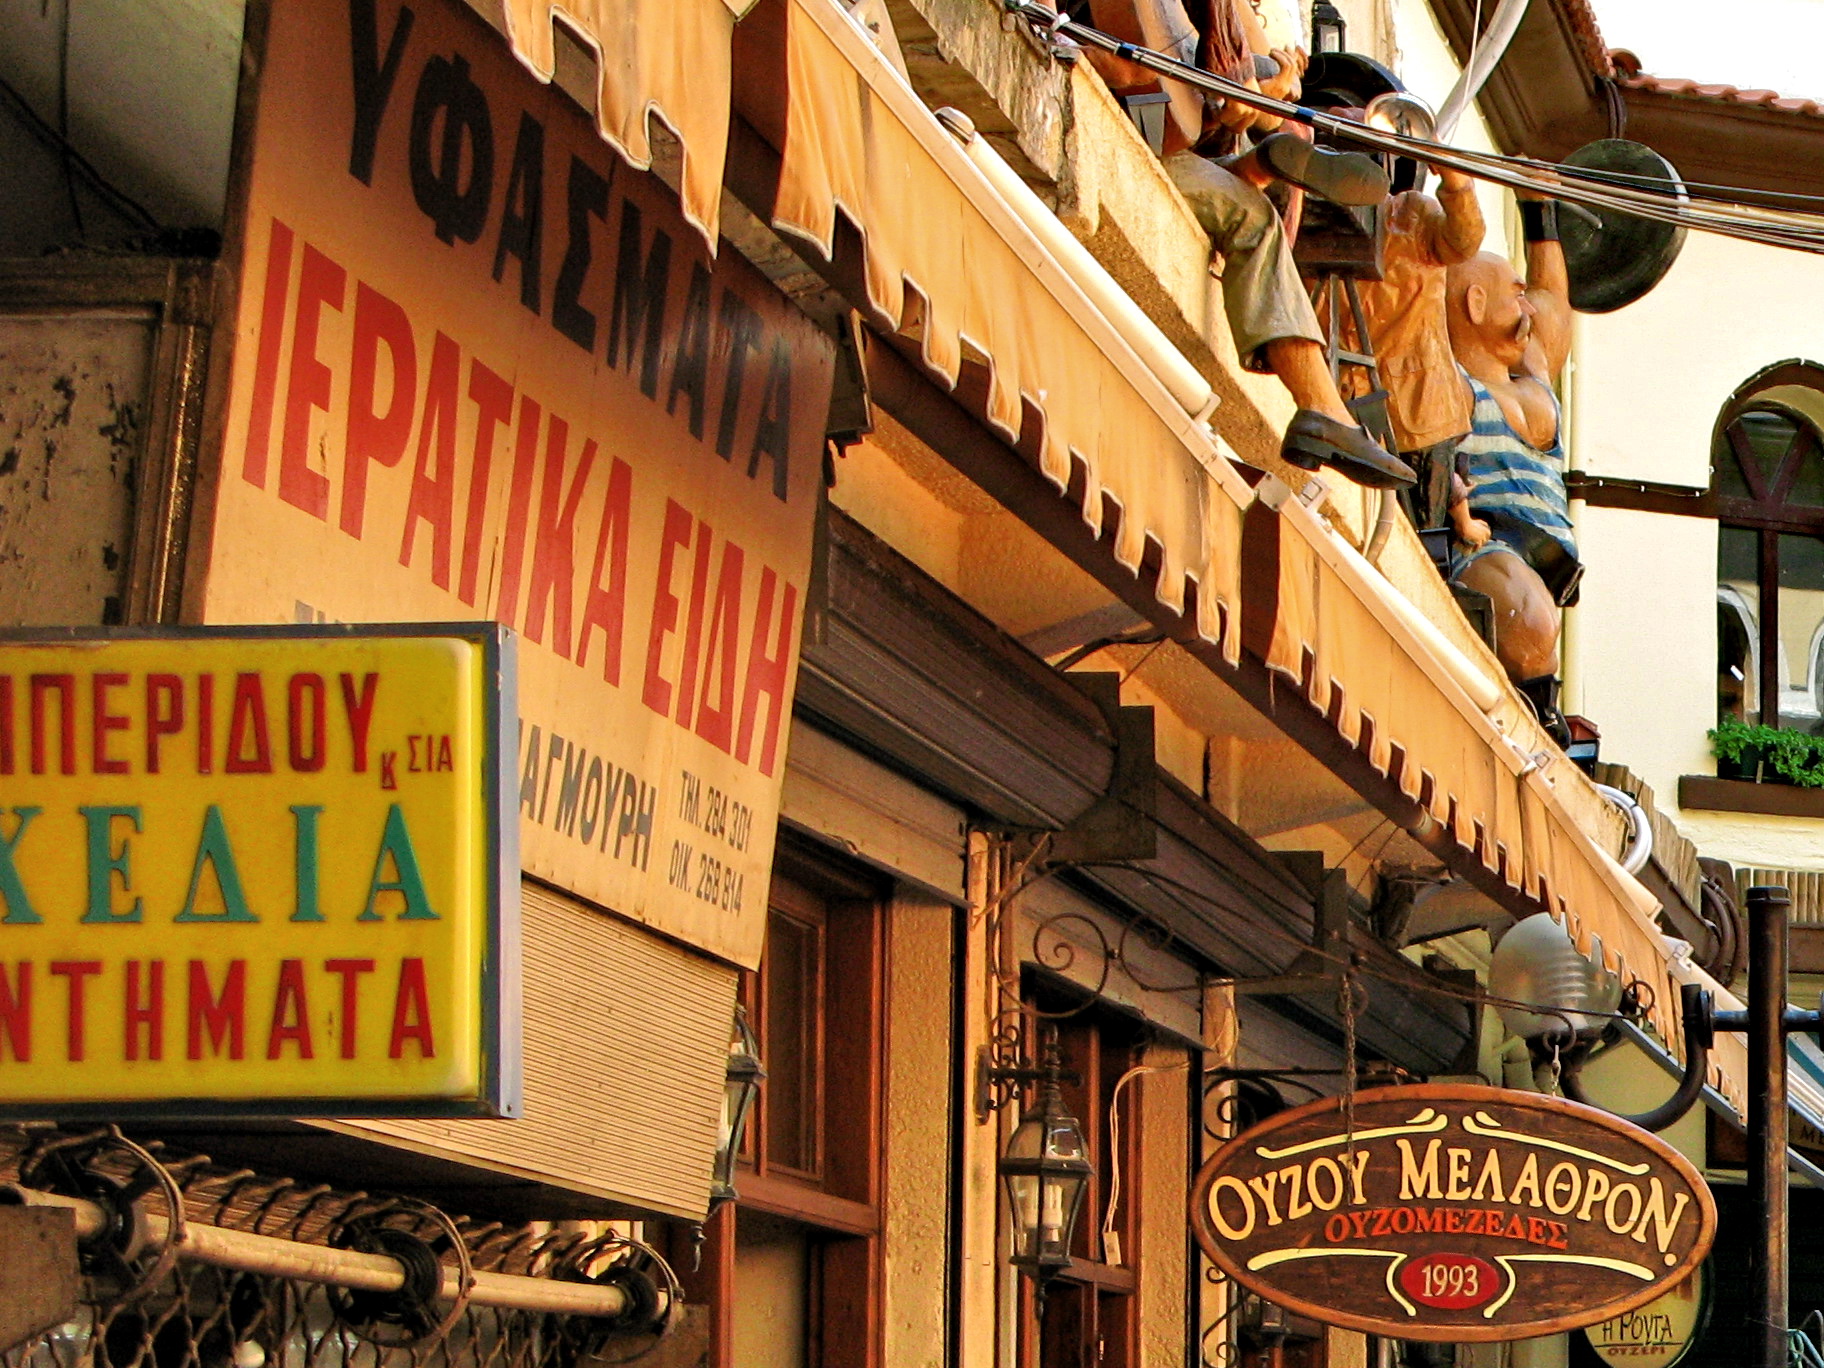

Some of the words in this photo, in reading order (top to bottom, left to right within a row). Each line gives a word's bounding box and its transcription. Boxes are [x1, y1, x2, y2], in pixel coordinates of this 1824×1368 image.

[349, 0, 792, 504] ΥΦΑΣΜΑΤΑ
[242, 217, 632, 688] ΙΕΡΑΤΙΚΑ
[641, 496, 798, 779] ΕΙΔΗ
[408, 735, 454, 773] ΣΙΑ
[1208, 1150, 1370, 1241] ΟΥΖΟΥ
[1325, 1207, 1569, 1250] ΟΥΖΟΜΕΖΕΔΕΣ
[1421, 1264, 1479, 1297] 1993
